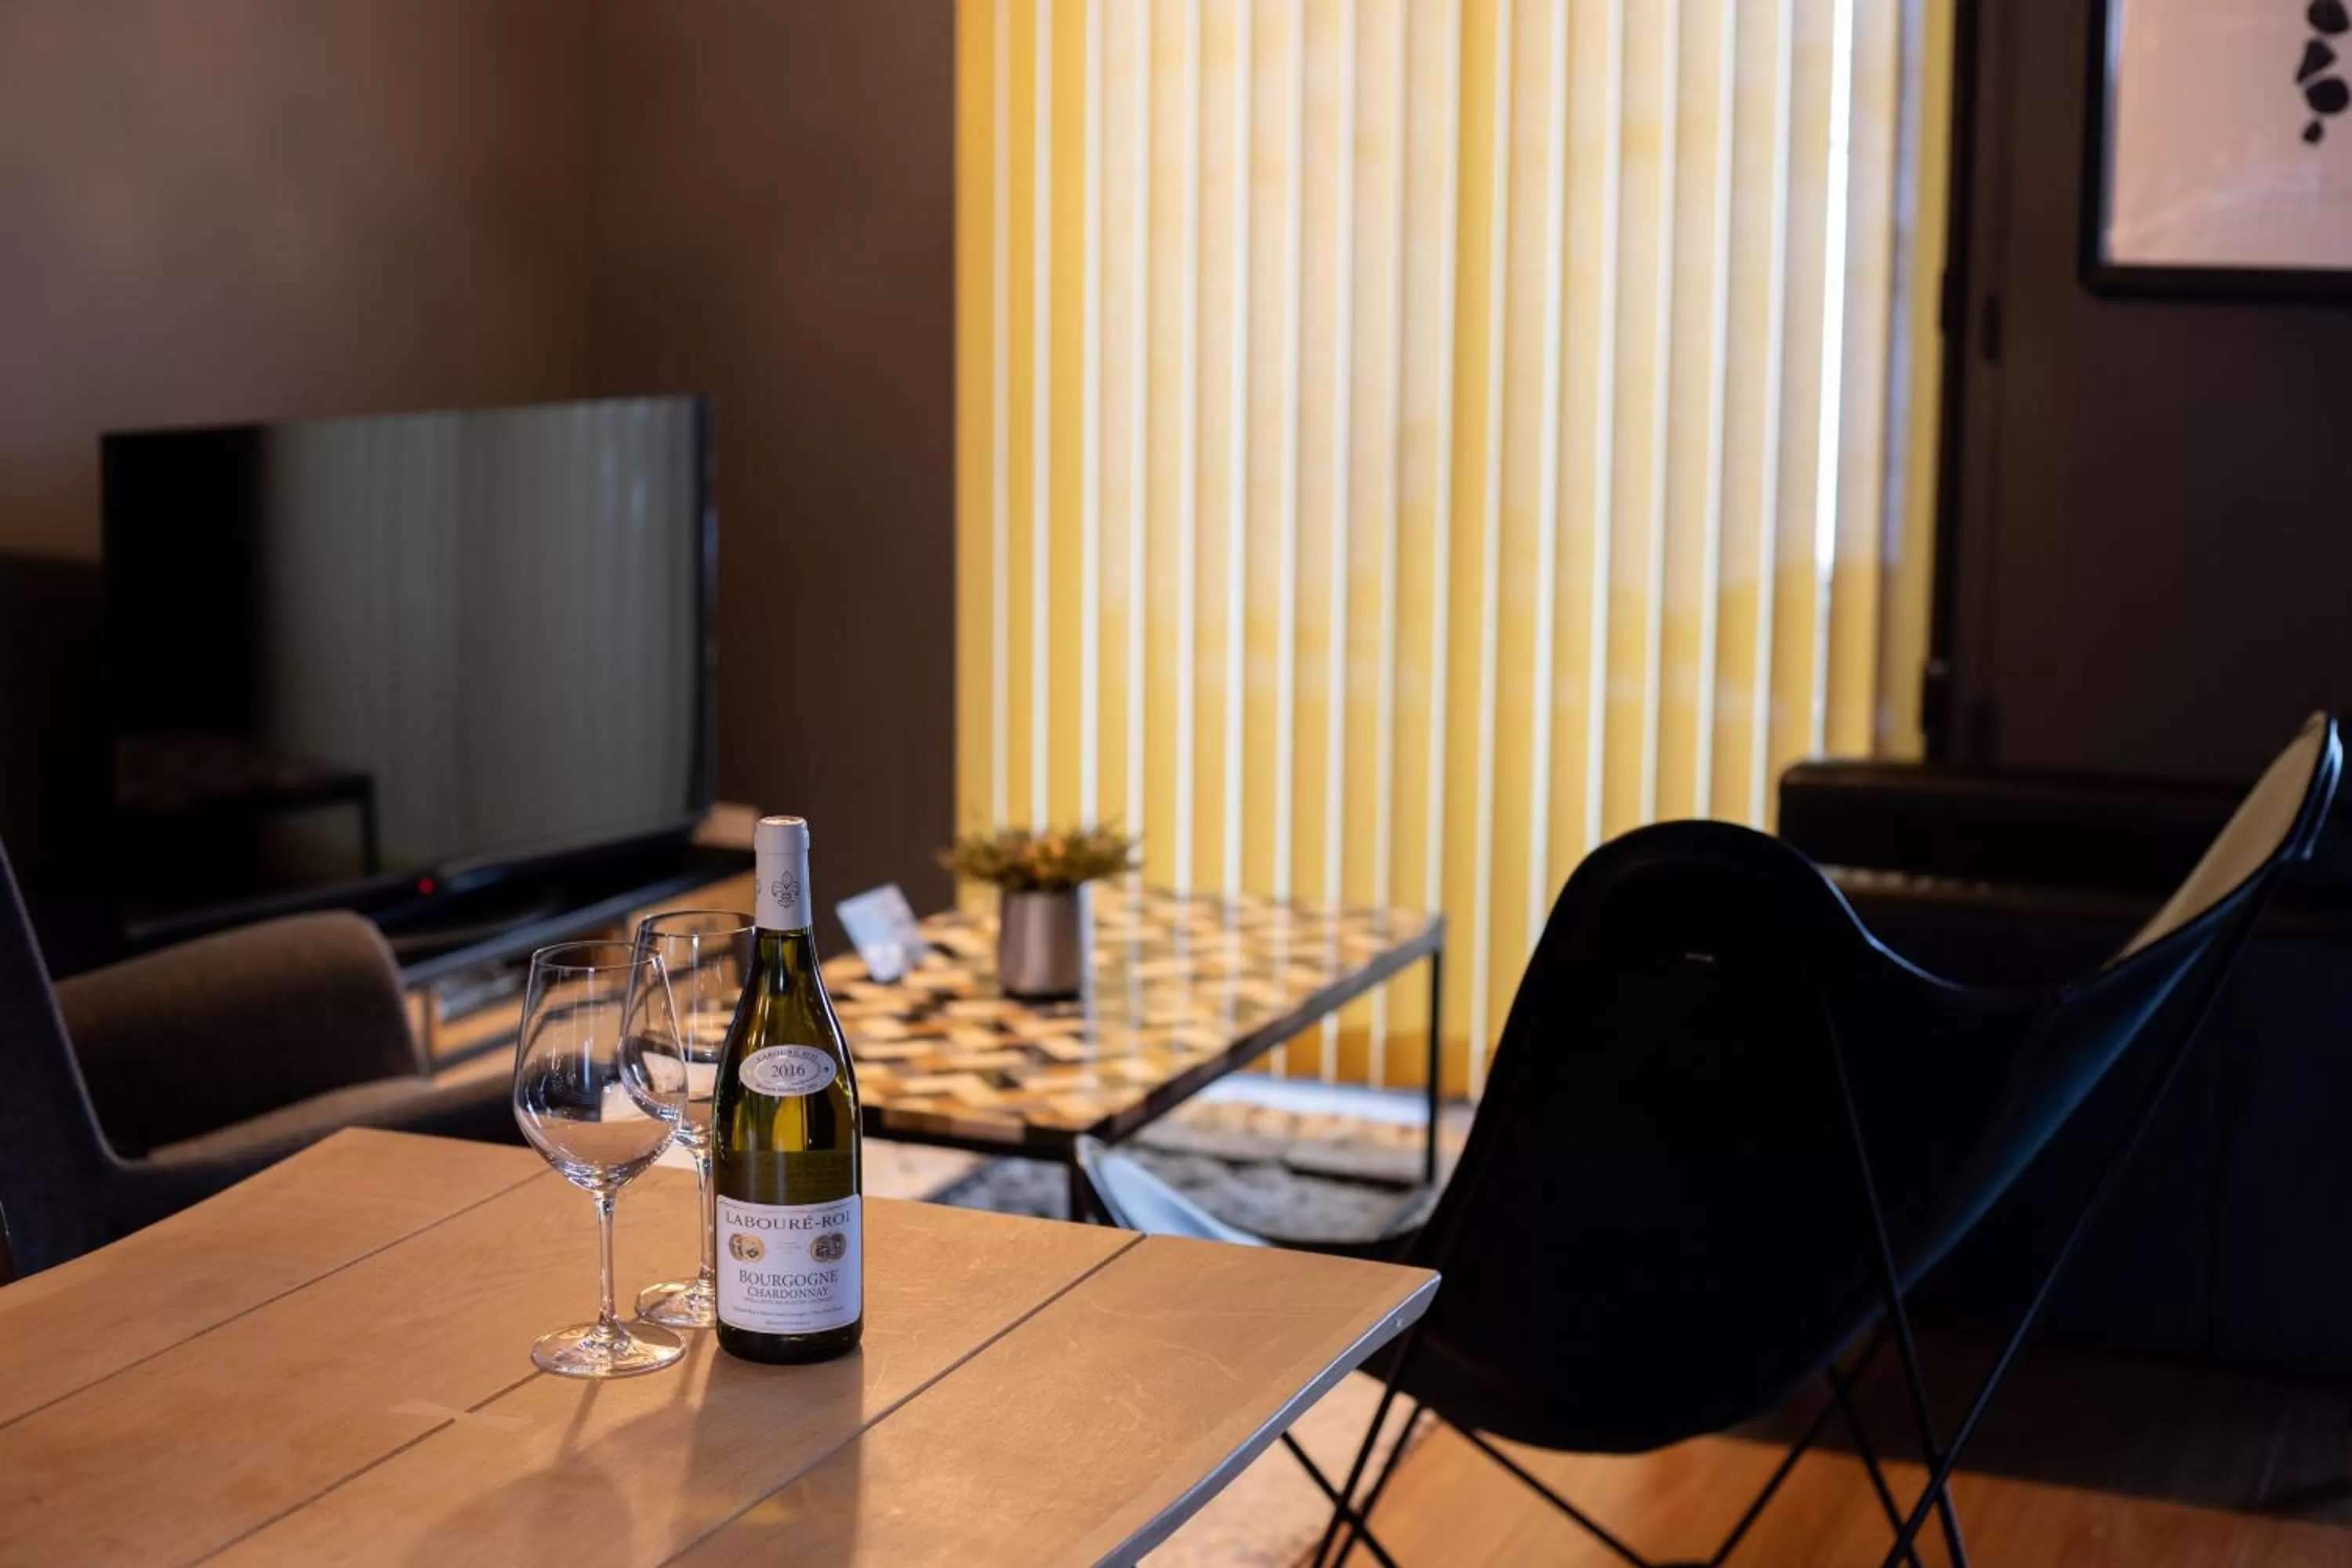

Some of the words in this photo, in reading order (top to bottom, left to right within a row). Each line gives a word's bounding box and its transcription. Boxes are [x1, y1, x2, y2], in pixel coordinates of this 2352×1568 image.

[771, 1064, 805, 1078] 2016
[726, 1210, 850, 1230] LABOURÉ-ROI
[739, 1269, 838, 1287] BOURGOGNE
[747, 1285, 829, 1299] CHARDONNAY
